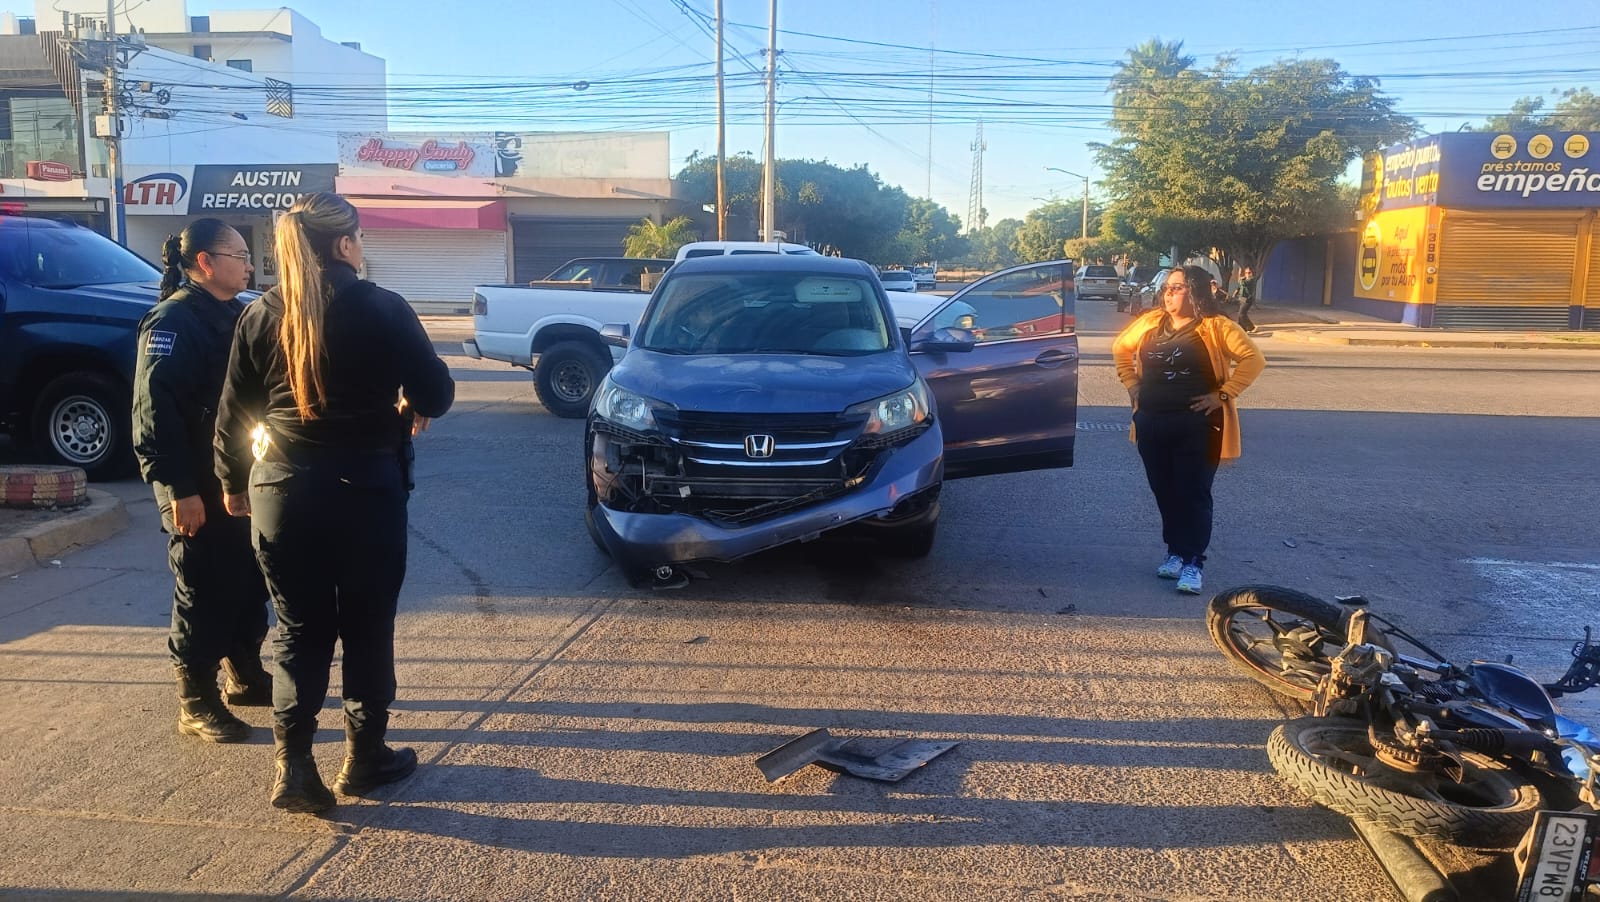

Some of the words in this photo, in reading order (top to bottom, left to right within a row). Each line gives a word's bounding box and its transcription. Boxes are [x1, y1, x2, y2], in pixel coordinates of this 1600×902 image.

[358, 138, 419, 170] Happy
[421, 139, 475, 170] Candy
[231, 171, 301, 187] AUSTIN
[1481, 160, 1561, 174] préstamos
[124, 183, 176, 205] LTH
[1386, 176, 1412, 198] autos
[1415, 169, 1439, 195] venta
[1540, 822, 1579, 897] 23VPW8
